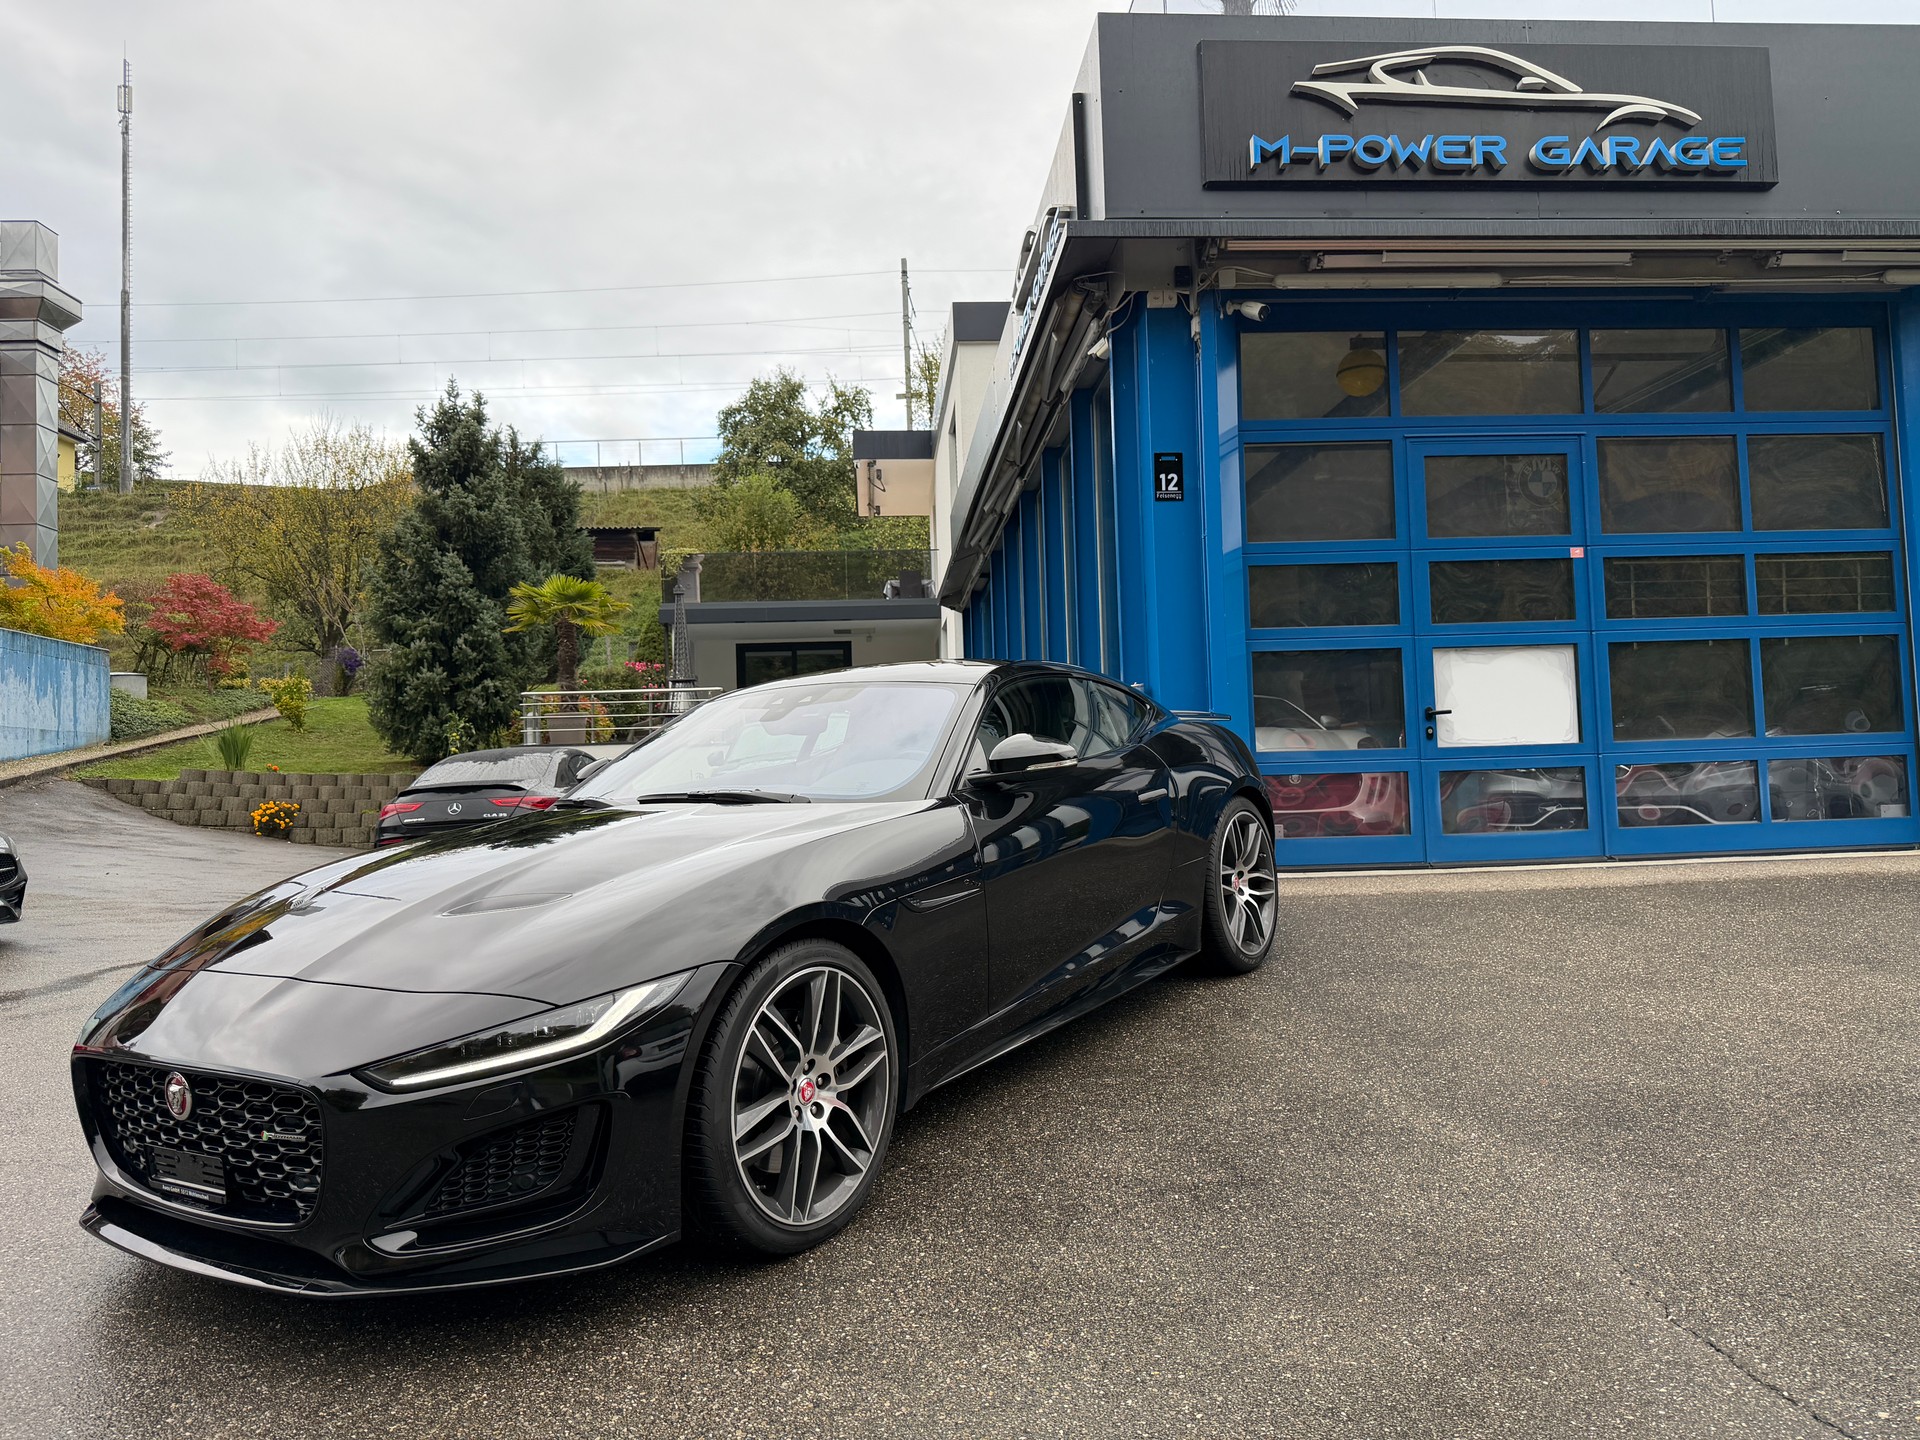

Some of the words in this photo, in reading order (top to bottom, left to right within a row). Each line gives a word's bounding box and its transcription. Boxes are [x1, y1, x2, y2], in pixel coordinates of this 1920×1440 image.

[1249, 133, 1508, 169] M-POWER
[1529, 135, 1748, 171] GARAGE
[1159, 473, 1178, 491] 12
